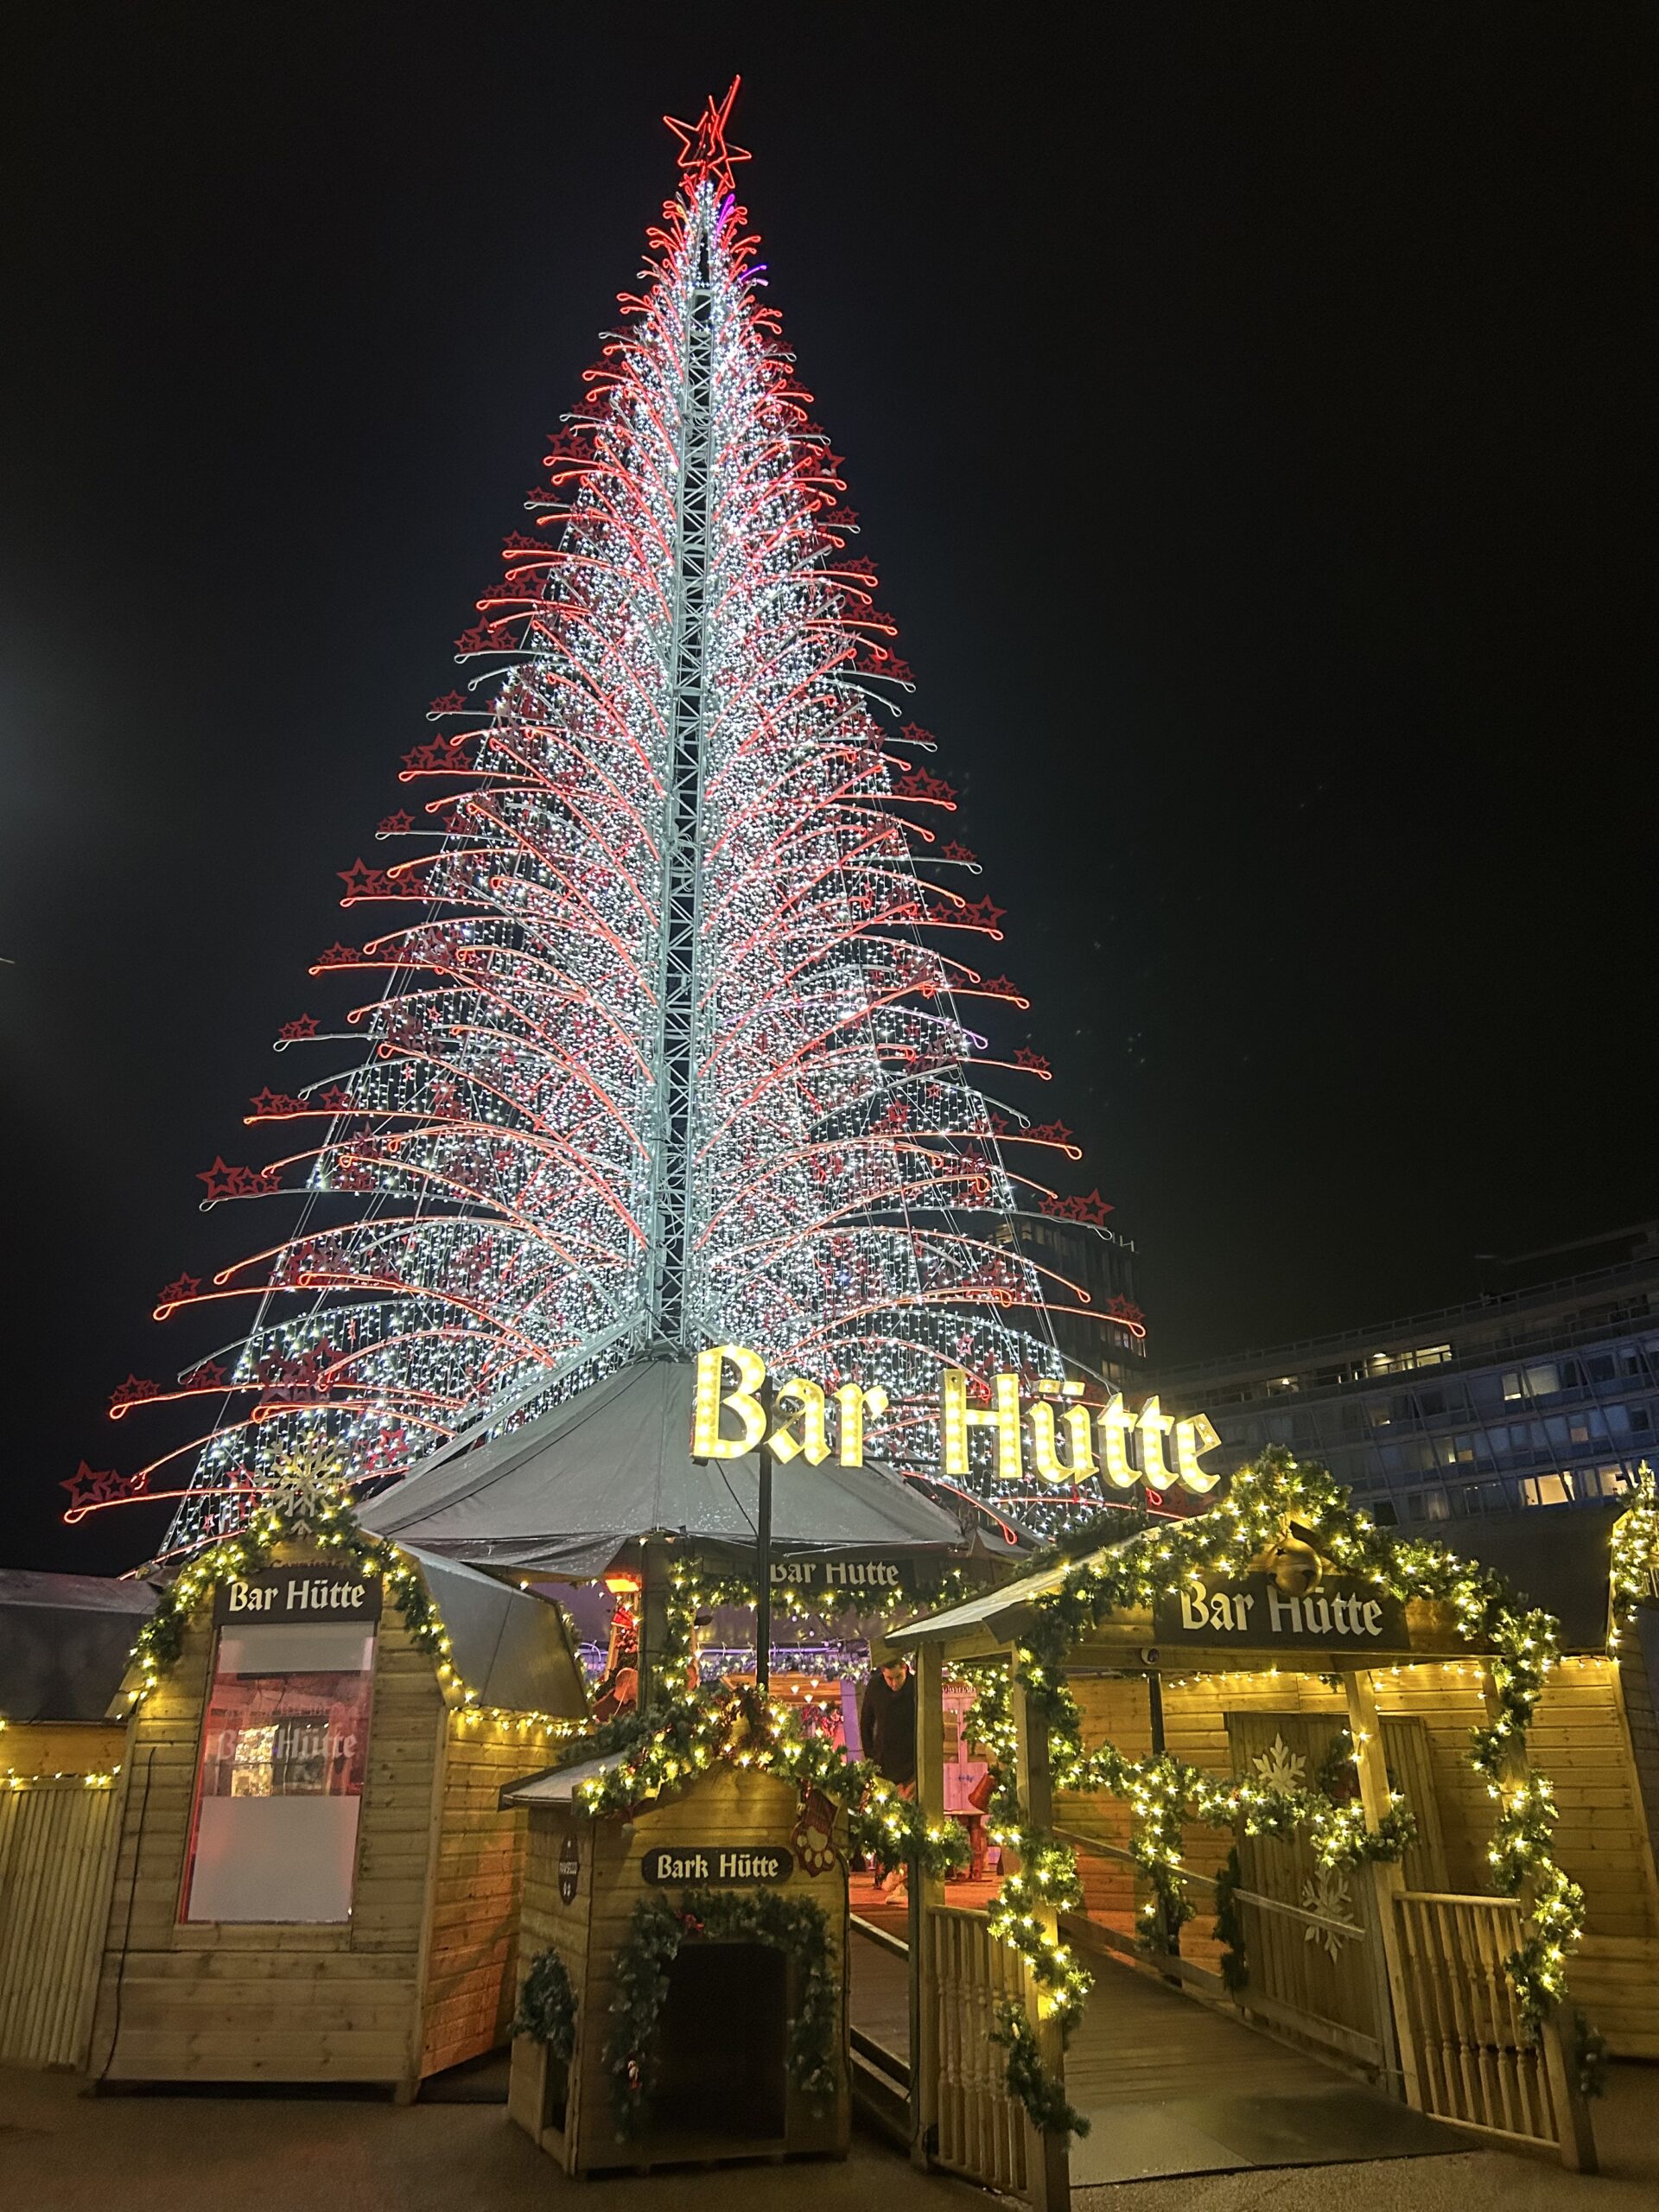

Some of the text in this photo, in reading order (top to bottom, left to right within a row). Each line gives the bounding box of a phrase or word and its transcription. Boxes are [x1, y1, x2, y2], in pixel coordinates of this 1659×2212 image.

[690, 1344, 1222, 1493] Bar Hütte
[770, 1562, 817, 1584] Bar
[229, 1580, 366, 1612] Bar Hütte
[1180, 1580, 1254, 1631] Bar
[657, 1853, 779, 1879] Bark Hütte
